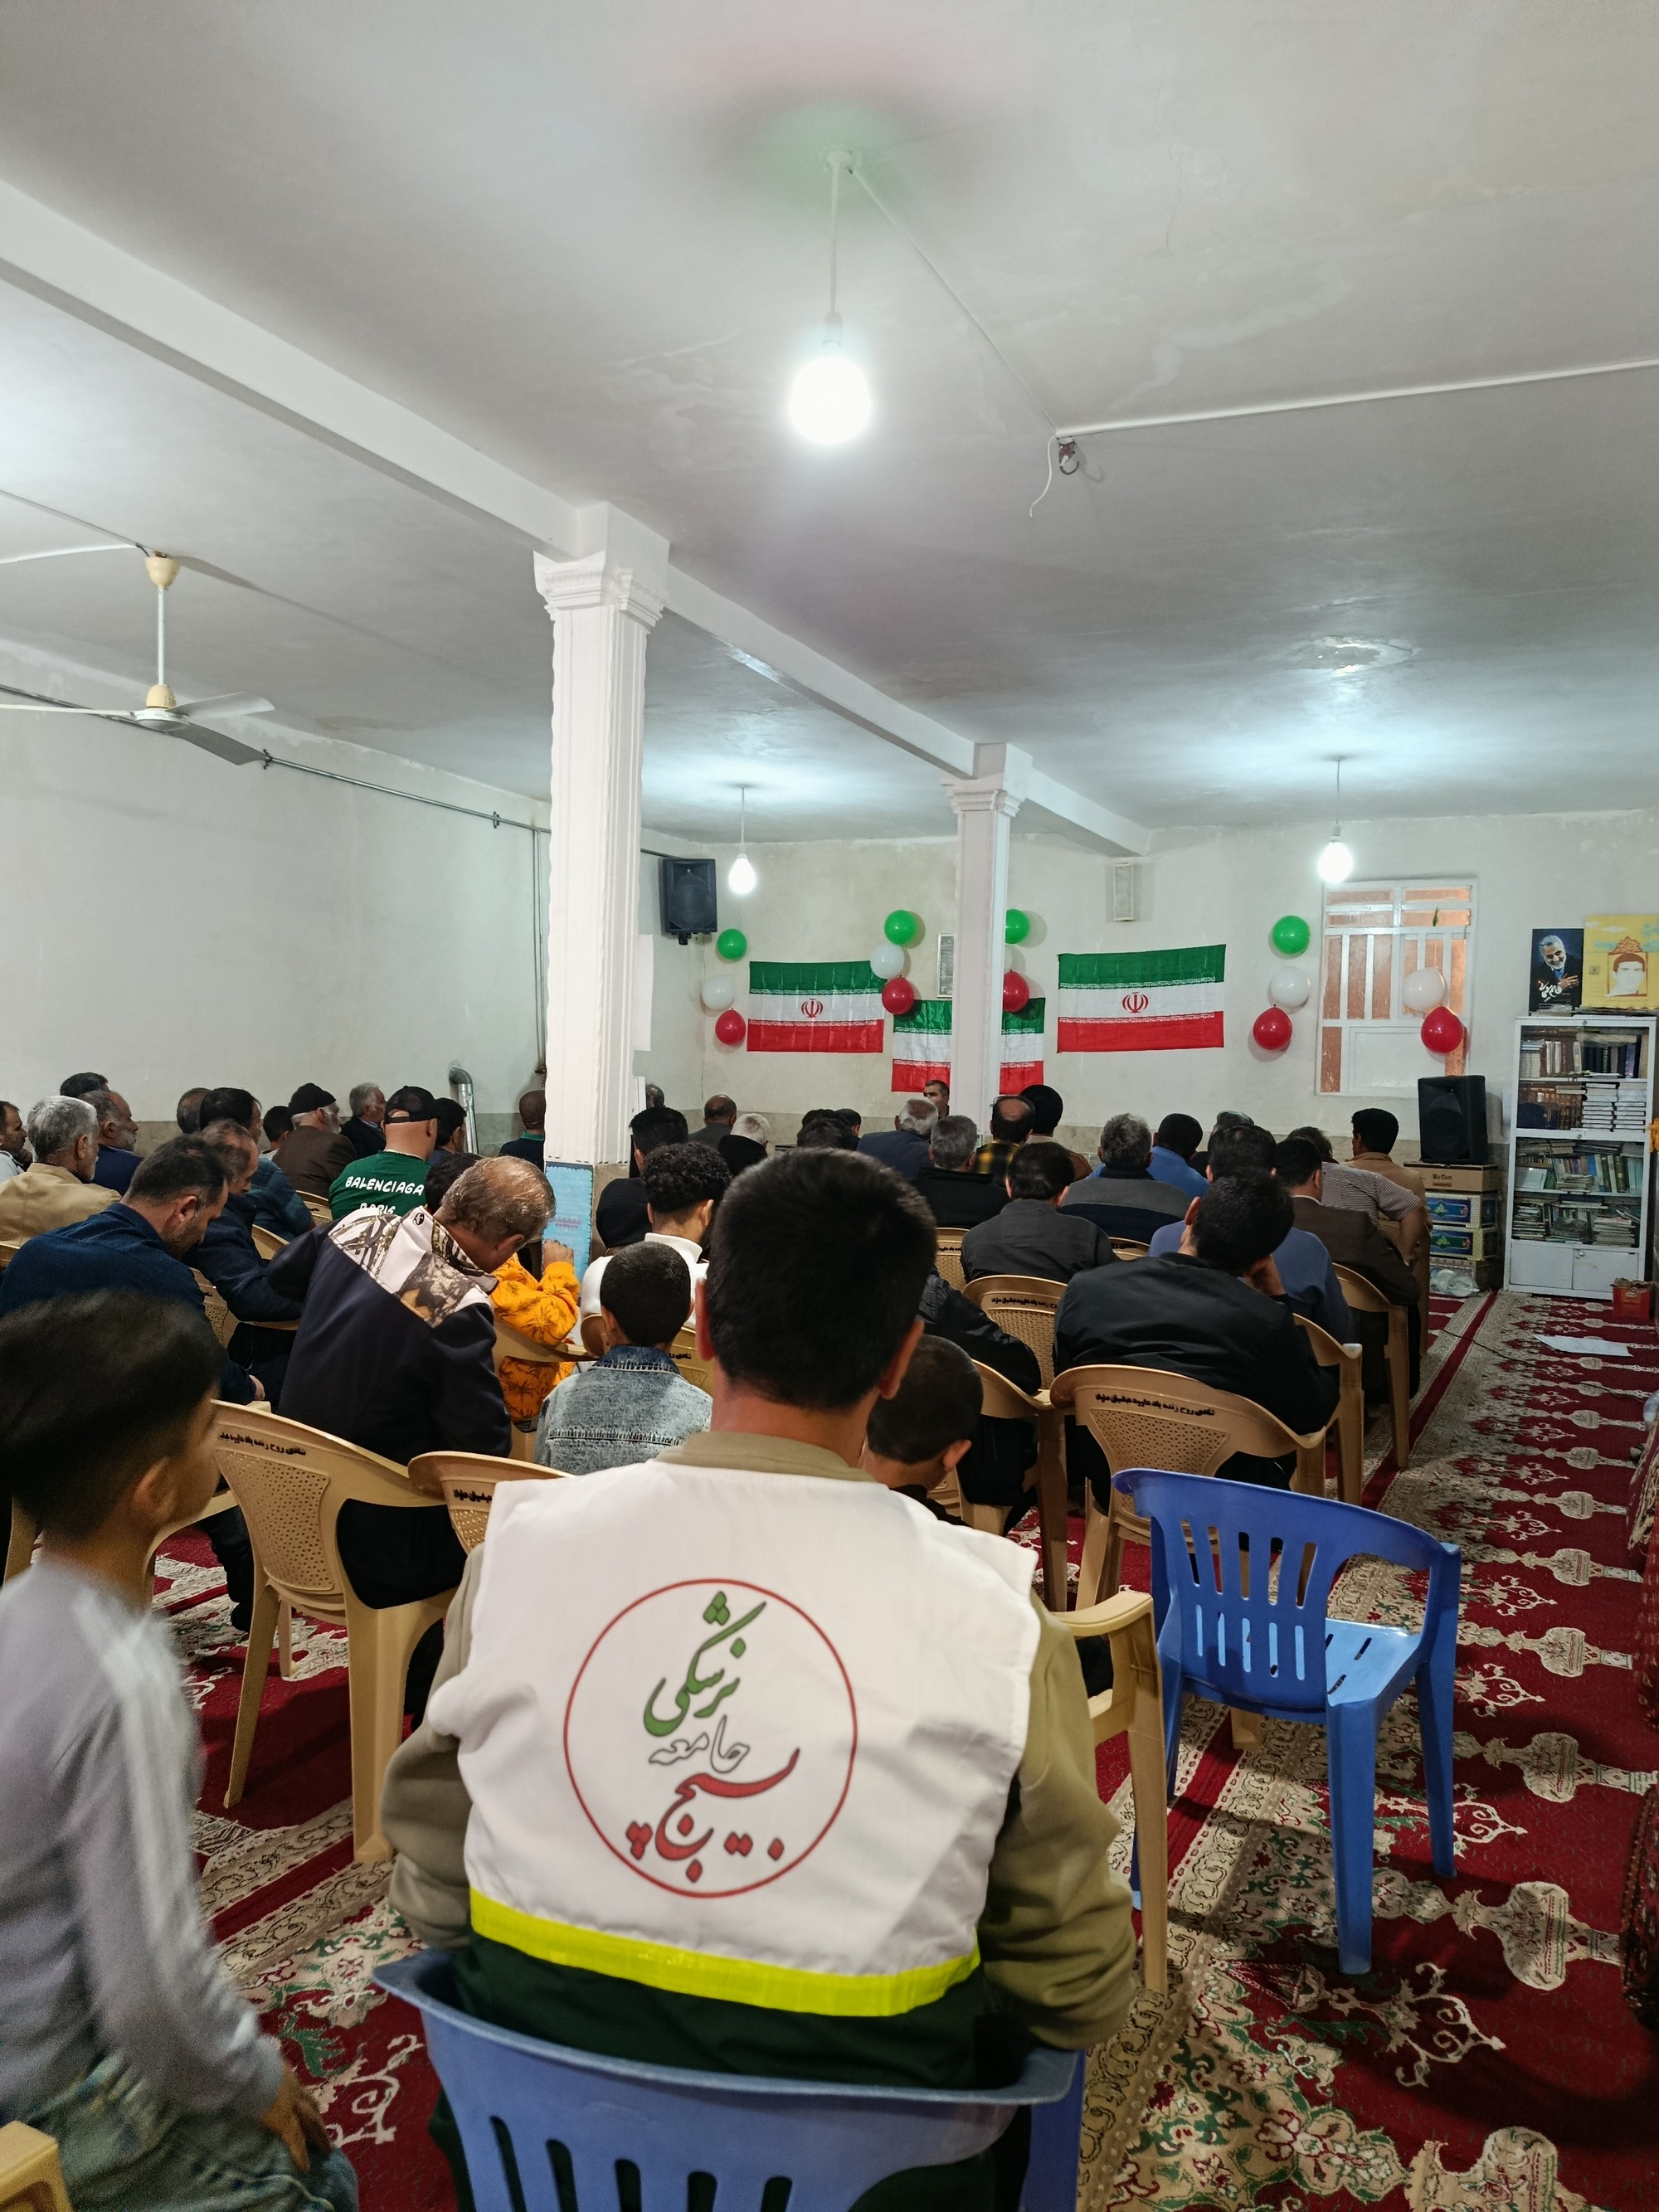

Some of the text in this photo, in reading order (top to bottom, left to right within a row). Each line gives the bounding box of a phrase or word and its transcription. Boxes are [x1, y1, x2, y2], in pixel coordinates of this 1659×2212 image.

[345, 1176, 425, 1196] BALENCIAGA
[1180, 1407, 1194, 1415] روح
[270, 1443, 285, 1453] روح
[649, 1714, 751, 1774] جامعه
[625, 1747, 800, 1883] بسیج
